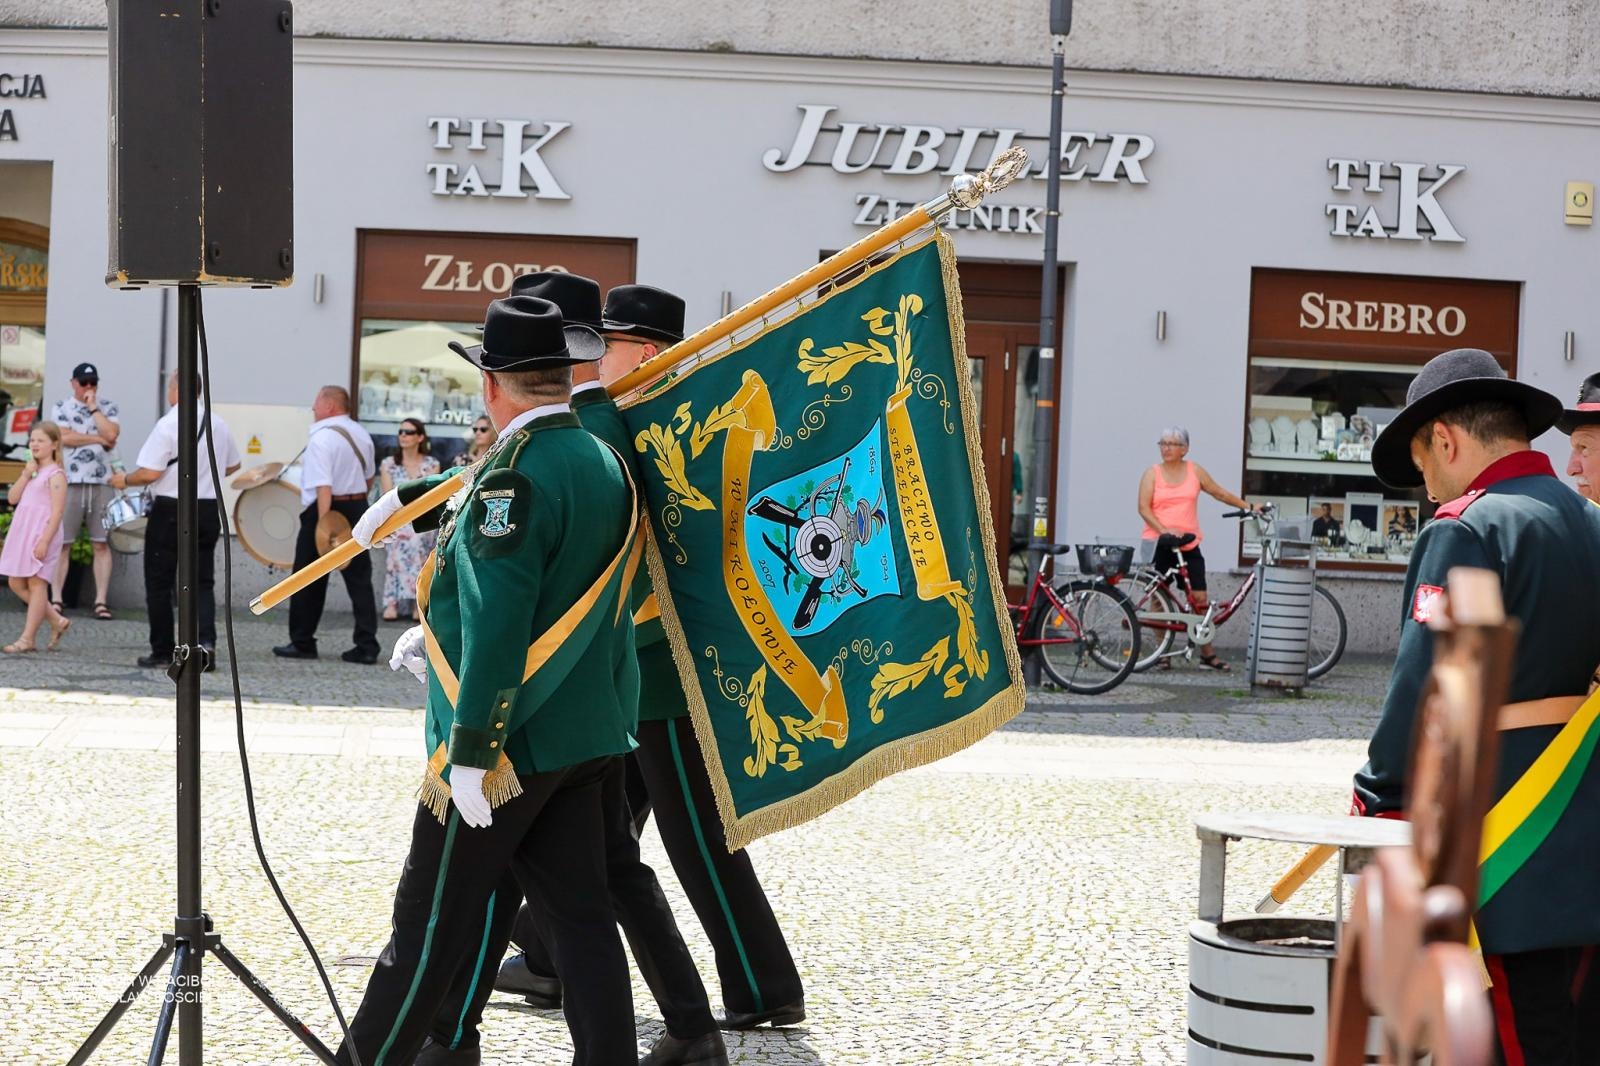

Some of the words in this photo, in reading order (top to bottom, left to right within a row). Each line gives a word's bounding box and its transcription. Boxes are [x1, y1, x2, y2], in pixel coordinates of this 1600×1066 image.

[762, 104, 1156, 184] JUBILER
[853, 193, 1044, 234] ZŁNIK
[421, 254, 569, 294] ZŁO
[1300, 291, 1466, 336] SREBRO
[888, 427, 927, 567] STRZELECKIE
[903, 444, 935, 541] BRACTWO
[757, 559, 776, 588] 2007
